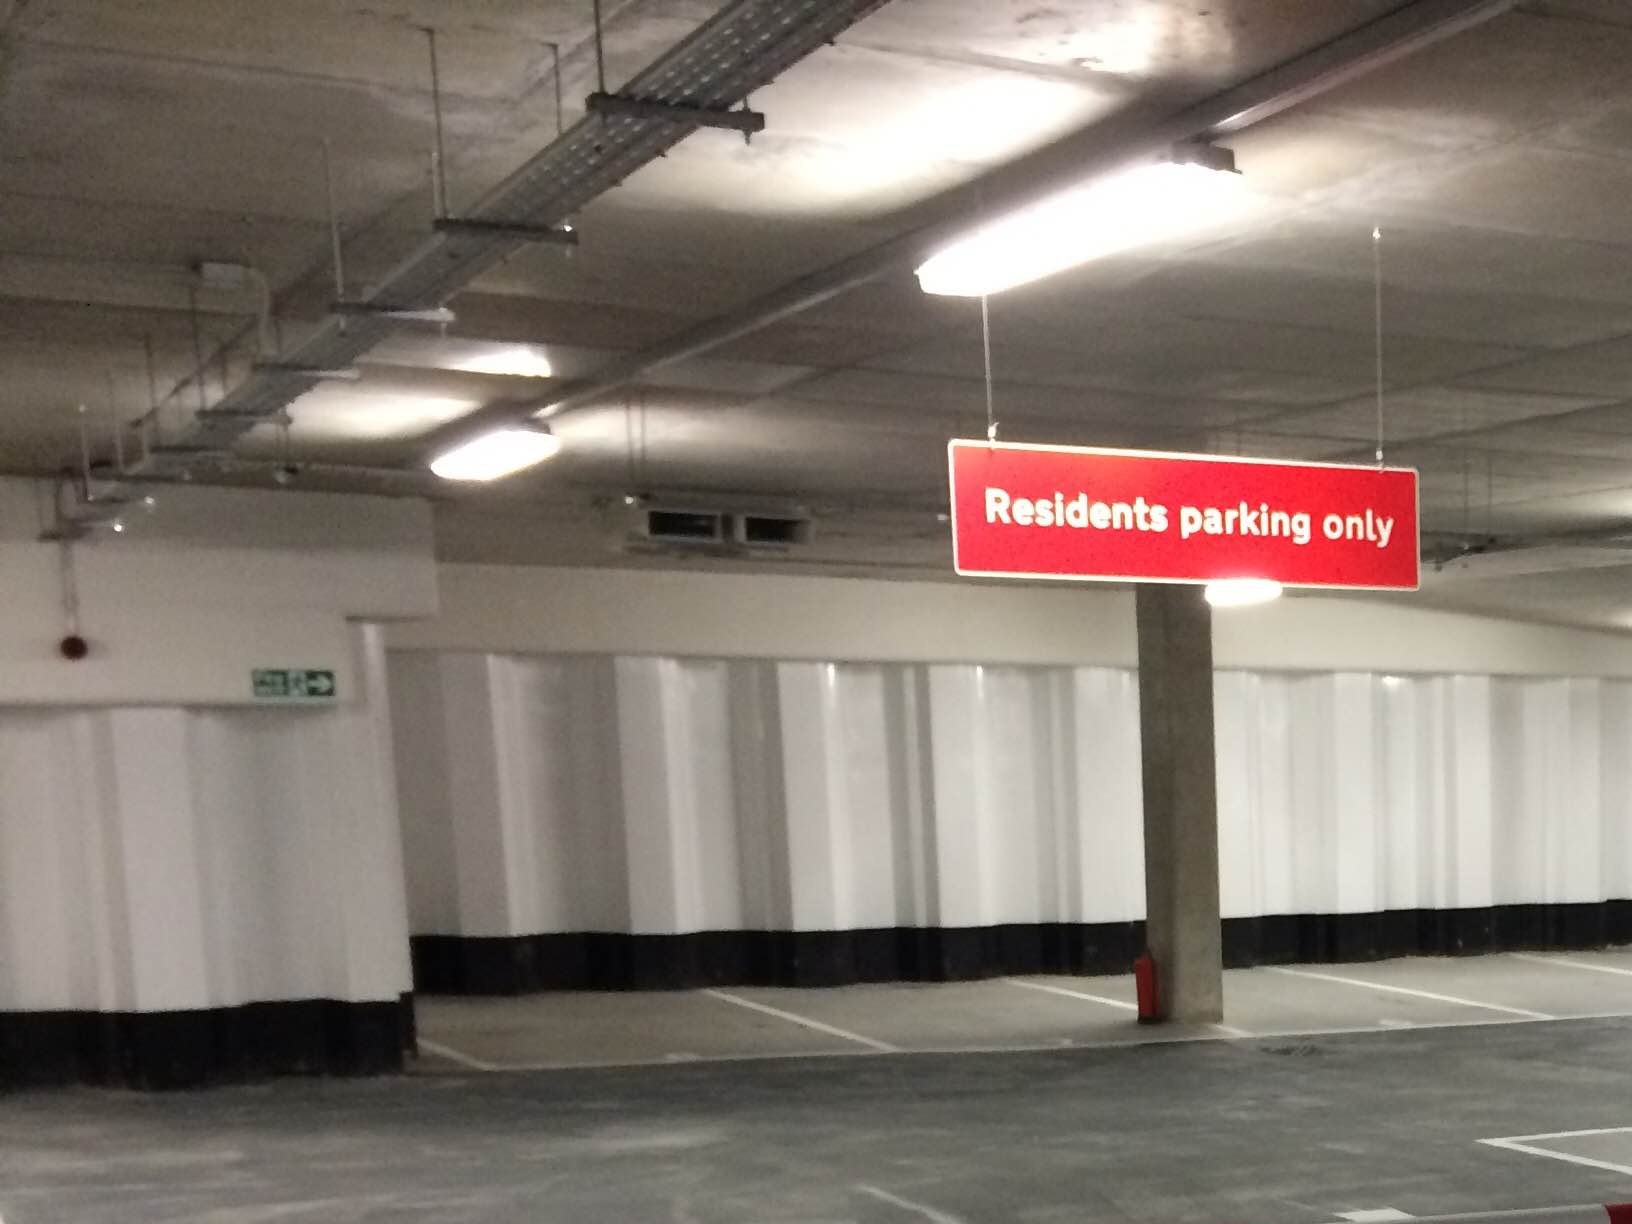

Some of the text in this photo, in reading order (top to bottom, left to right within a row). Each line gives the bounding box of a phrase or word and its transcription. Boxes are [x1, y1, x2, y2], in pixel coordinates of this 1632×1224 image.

[985, 487, 1394, 548] Residents parking only
